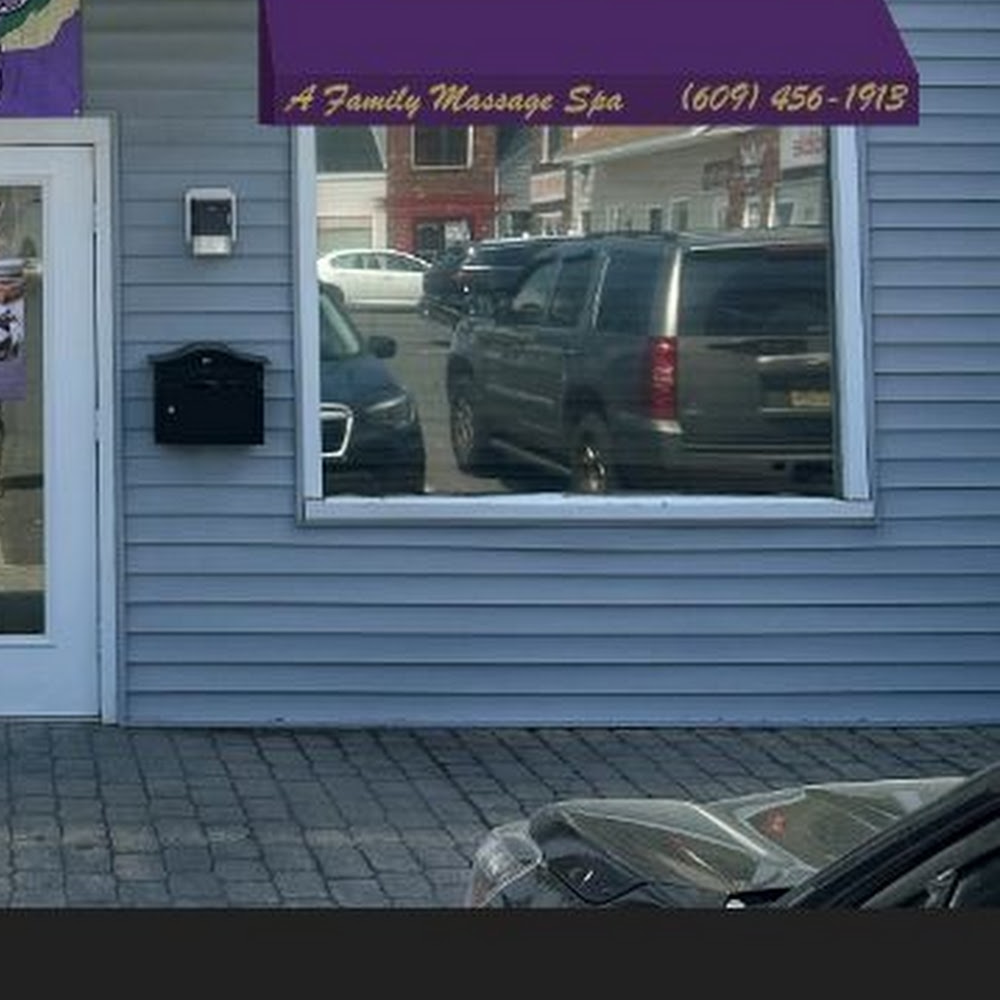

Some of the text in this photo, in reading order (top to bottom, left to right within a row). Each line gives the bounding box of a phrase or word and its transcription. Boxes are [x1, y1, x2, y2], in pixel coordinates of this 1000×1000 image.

[284, 82, 625, 120] A Family Massage Spa
[681, 82, 909, 112] (609) 456-1913
